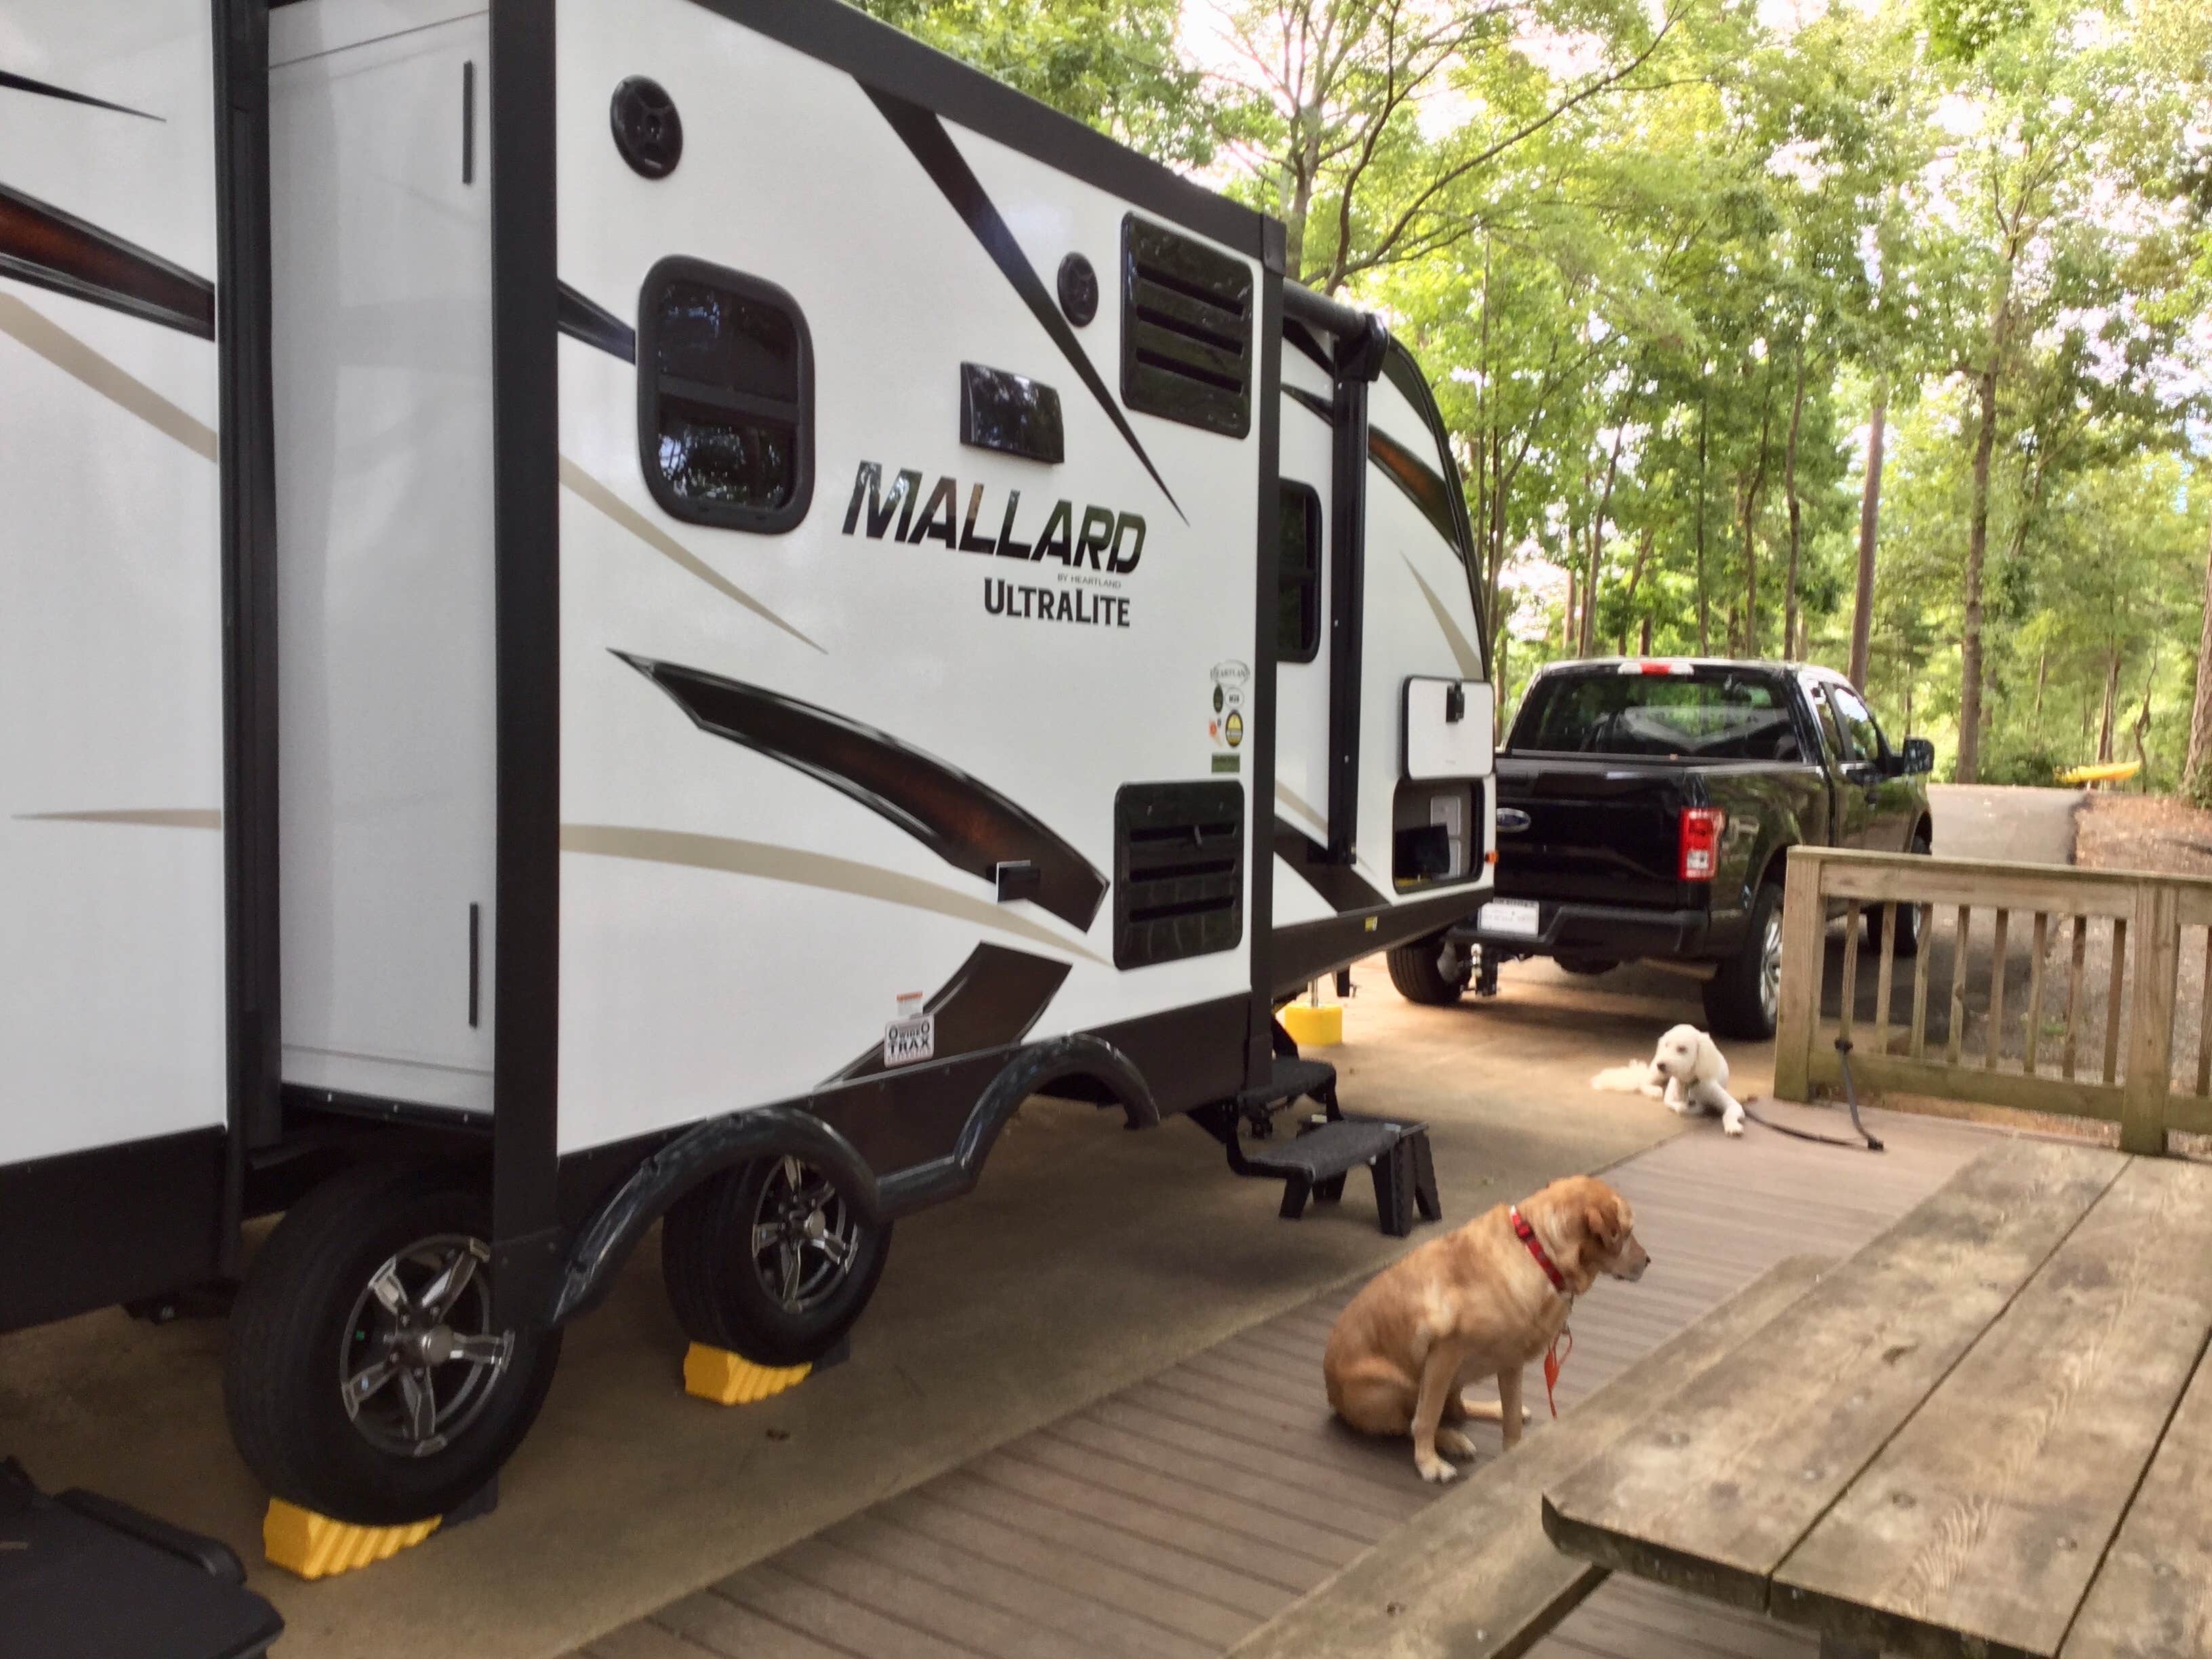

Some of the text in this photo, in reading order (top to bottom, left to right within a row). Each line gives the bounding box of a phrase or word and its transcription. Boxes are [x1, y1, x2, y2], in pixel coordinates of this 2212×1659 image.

[841, 459, 1147, 574] MALLARD
[1057, 573, 1122, 589] BY HEARTLAND
